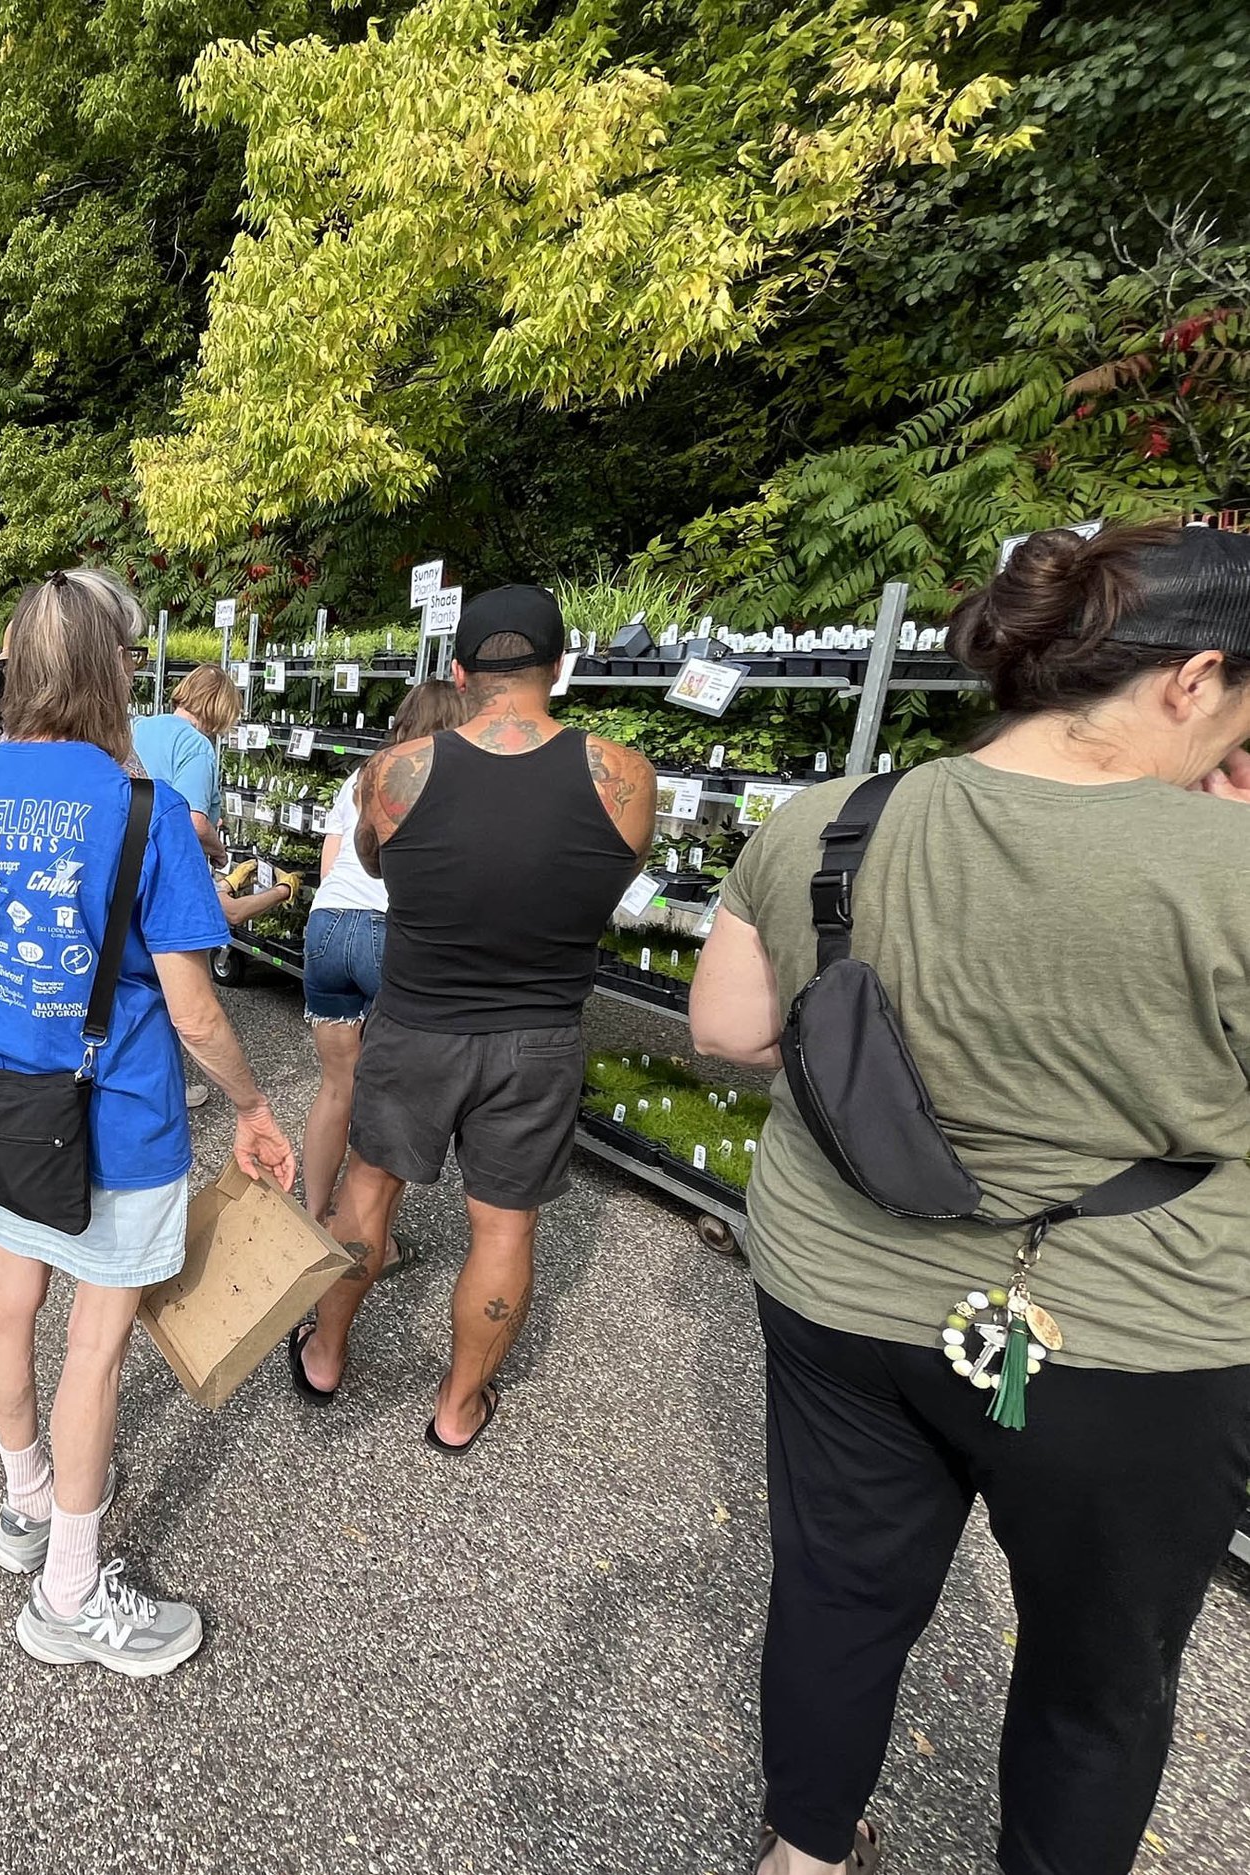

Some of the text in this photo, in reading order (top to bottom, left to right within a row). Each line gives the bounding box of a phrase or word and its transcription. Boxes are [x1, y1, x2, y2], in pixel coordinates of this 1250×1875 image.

[414, 566, 440, 582] Sunny
[414, 582, 438, 596] Plants
[430, 592, 457, 608] Shade
[430, 609, 456, 624] Plants
[20, 945, 38, 958] CHS
[36, 1002, 83, 1011] BAUMANN
